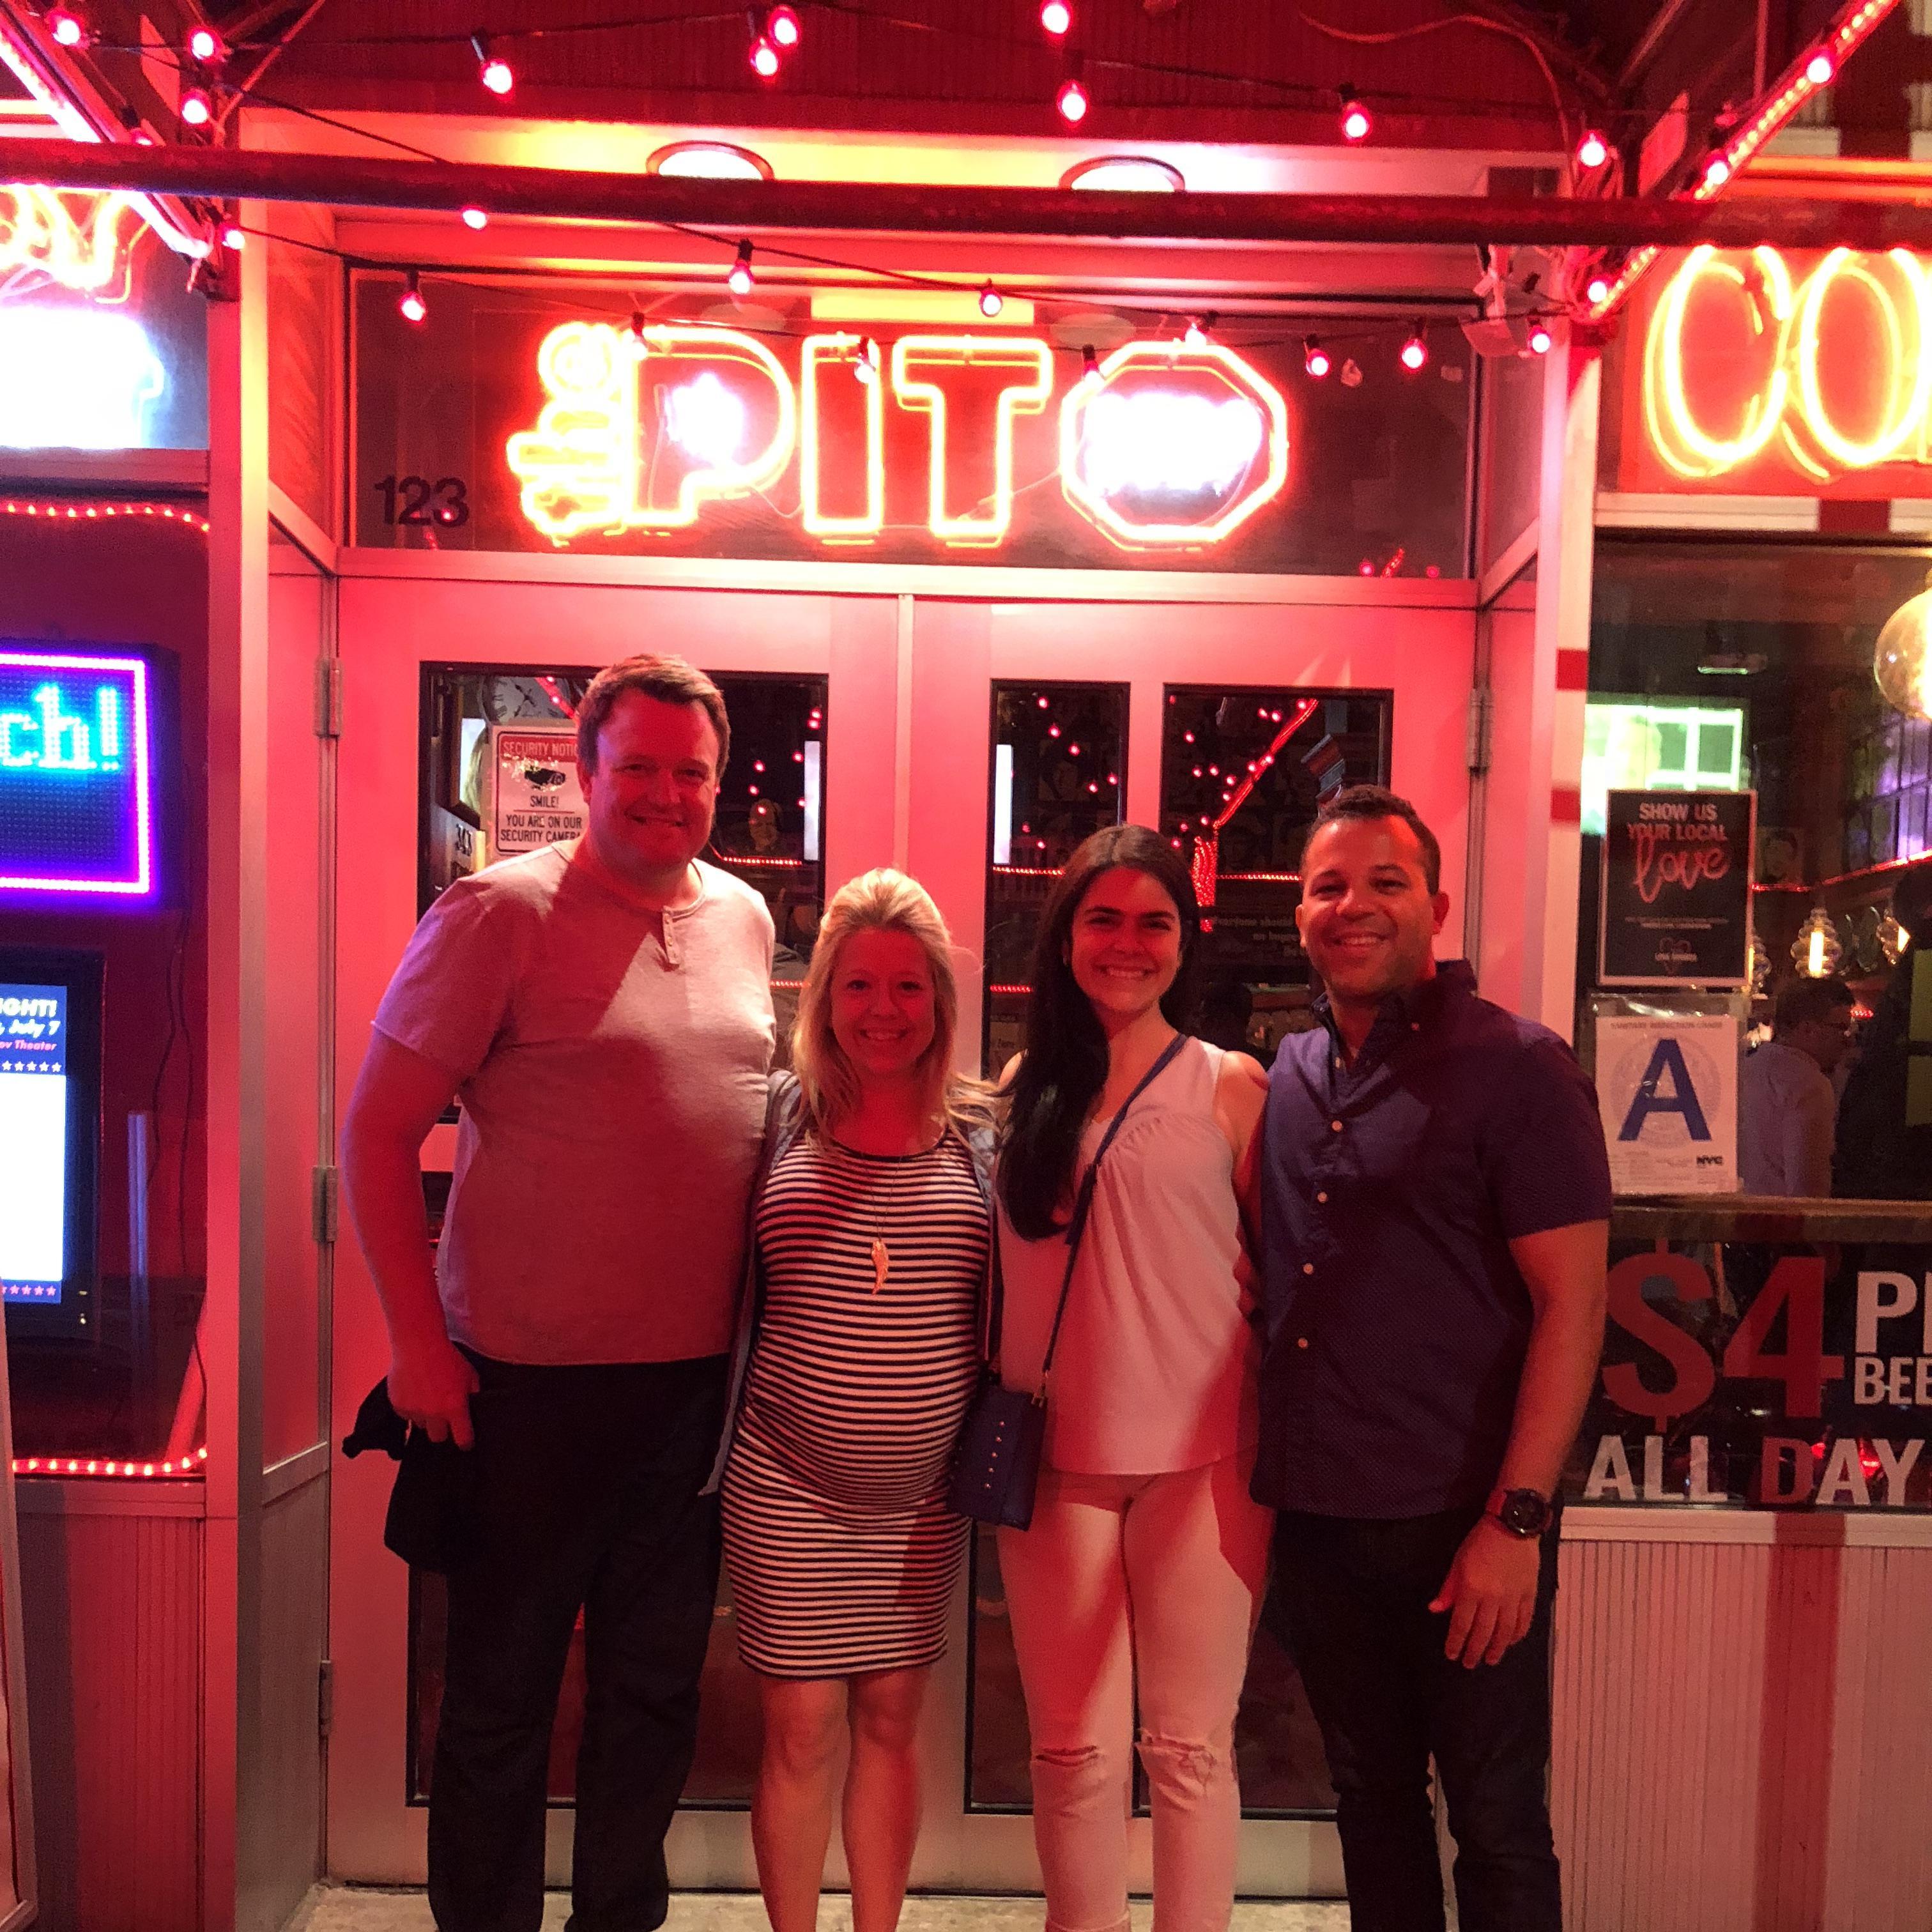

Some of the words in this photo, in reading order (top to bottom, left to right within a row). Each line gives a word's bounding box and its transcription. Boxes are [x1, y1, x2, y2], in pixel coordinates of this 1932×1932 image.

[374, 475, 470, 528] 123
[0, 682, 120, 771] ch!
[503, 741, 549, 756] SECURITY
[530, 795, 559, 808] SMILE!
[1639, 802, 1689, 821] SHOW
[1694, 803, 1718, 820] US
[506, 815, 525, 826] YOU
[528, 815, 545, 827] ARE
[548, 816, 560, 828] ON
[563, 816, 582, 829] OUR
[1628, 822, 1670, 841] YOUR
[1676, 822, 1728, 841] LOCAL
[501, 829, 542, 842] SECURITY
[1633, 824, 1731, 904] love
[8, 1018, 45, 1038] July
[49, 1021, 61, 1036] 7
[15, 1039, 57, 1051] Theater
[1617, 1039, 1712, 1141] A
[1602, 1238, 1844, 1433] $4
[1583, 1435, 1728, 1503] ALL
[1759, 1436, 1925, 1506] DAY
